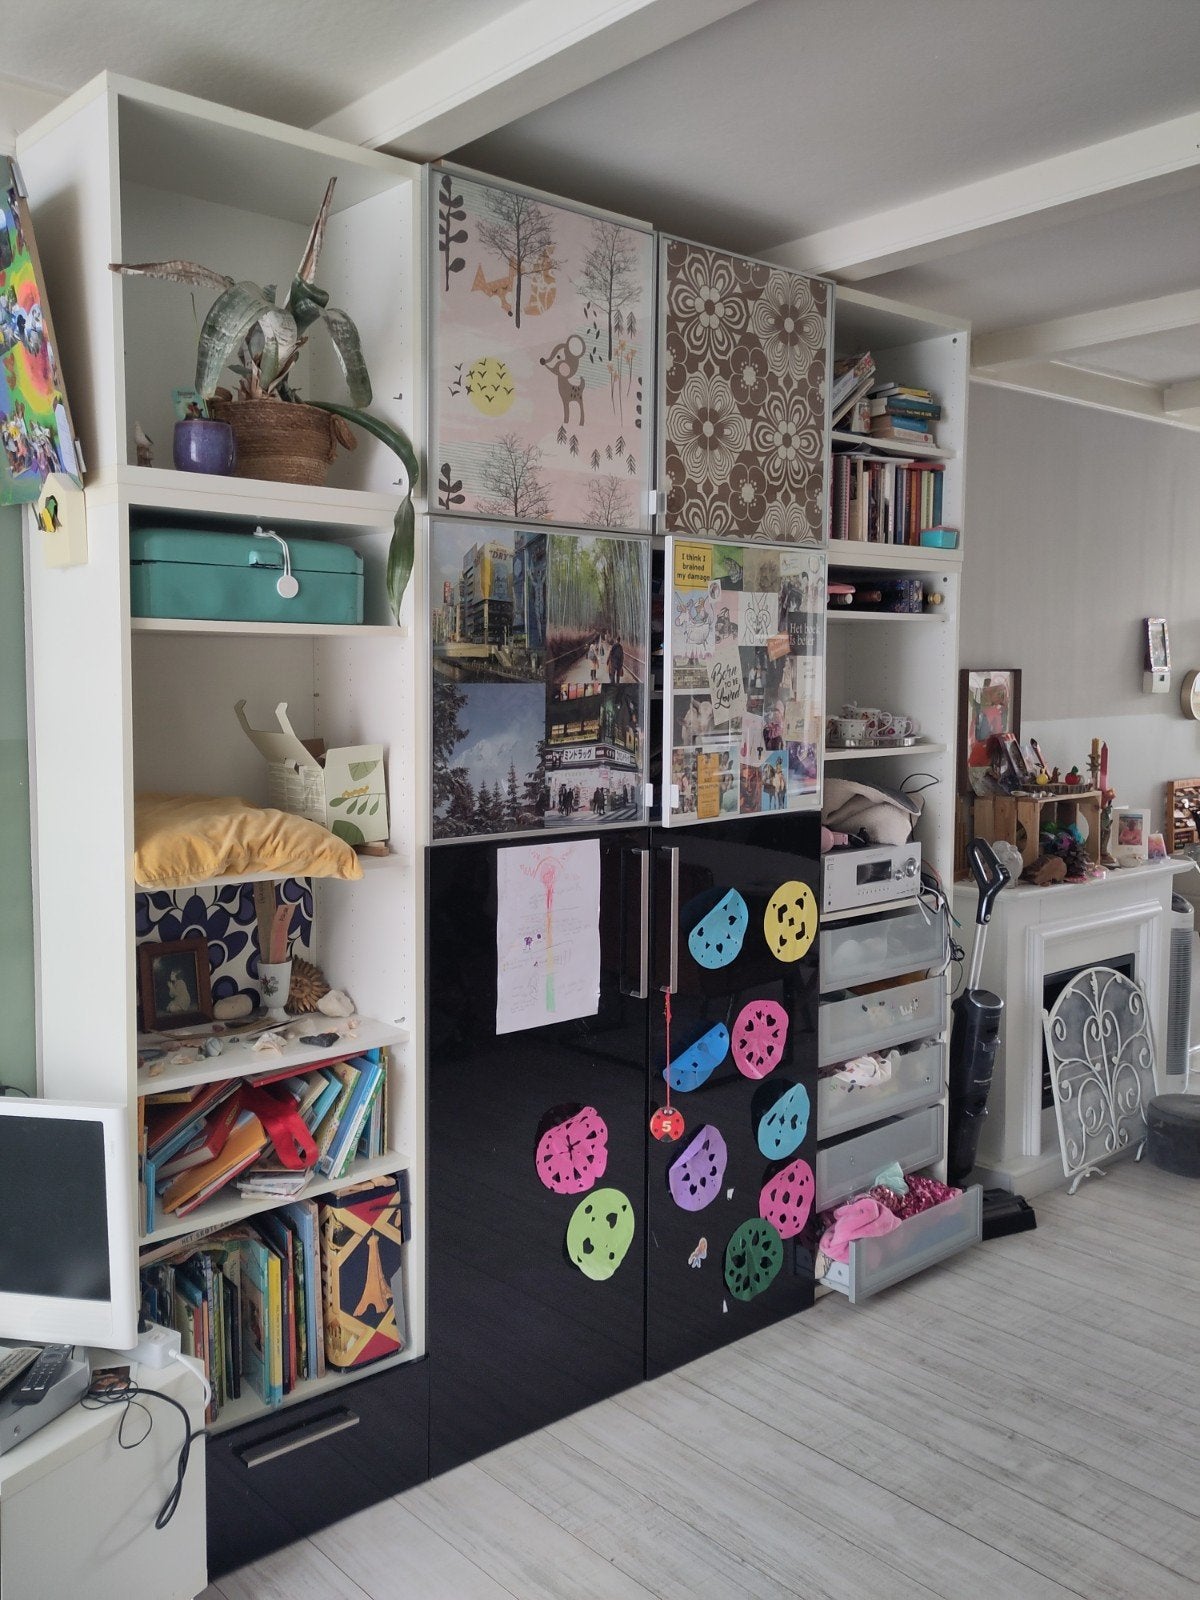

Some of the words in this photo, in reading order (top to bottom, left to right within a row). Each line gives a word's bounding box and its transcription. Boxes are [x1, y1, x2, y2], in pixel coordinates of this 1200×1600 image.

[682, 562, 705, 571] brained
[687, 573, 710, 582] damage
[790, 622, 803, 634] Het
[711, 662, 737, 688] Born
[714, 683, 741, 710] Loved
[662, 1120, 671, 1133] 5
